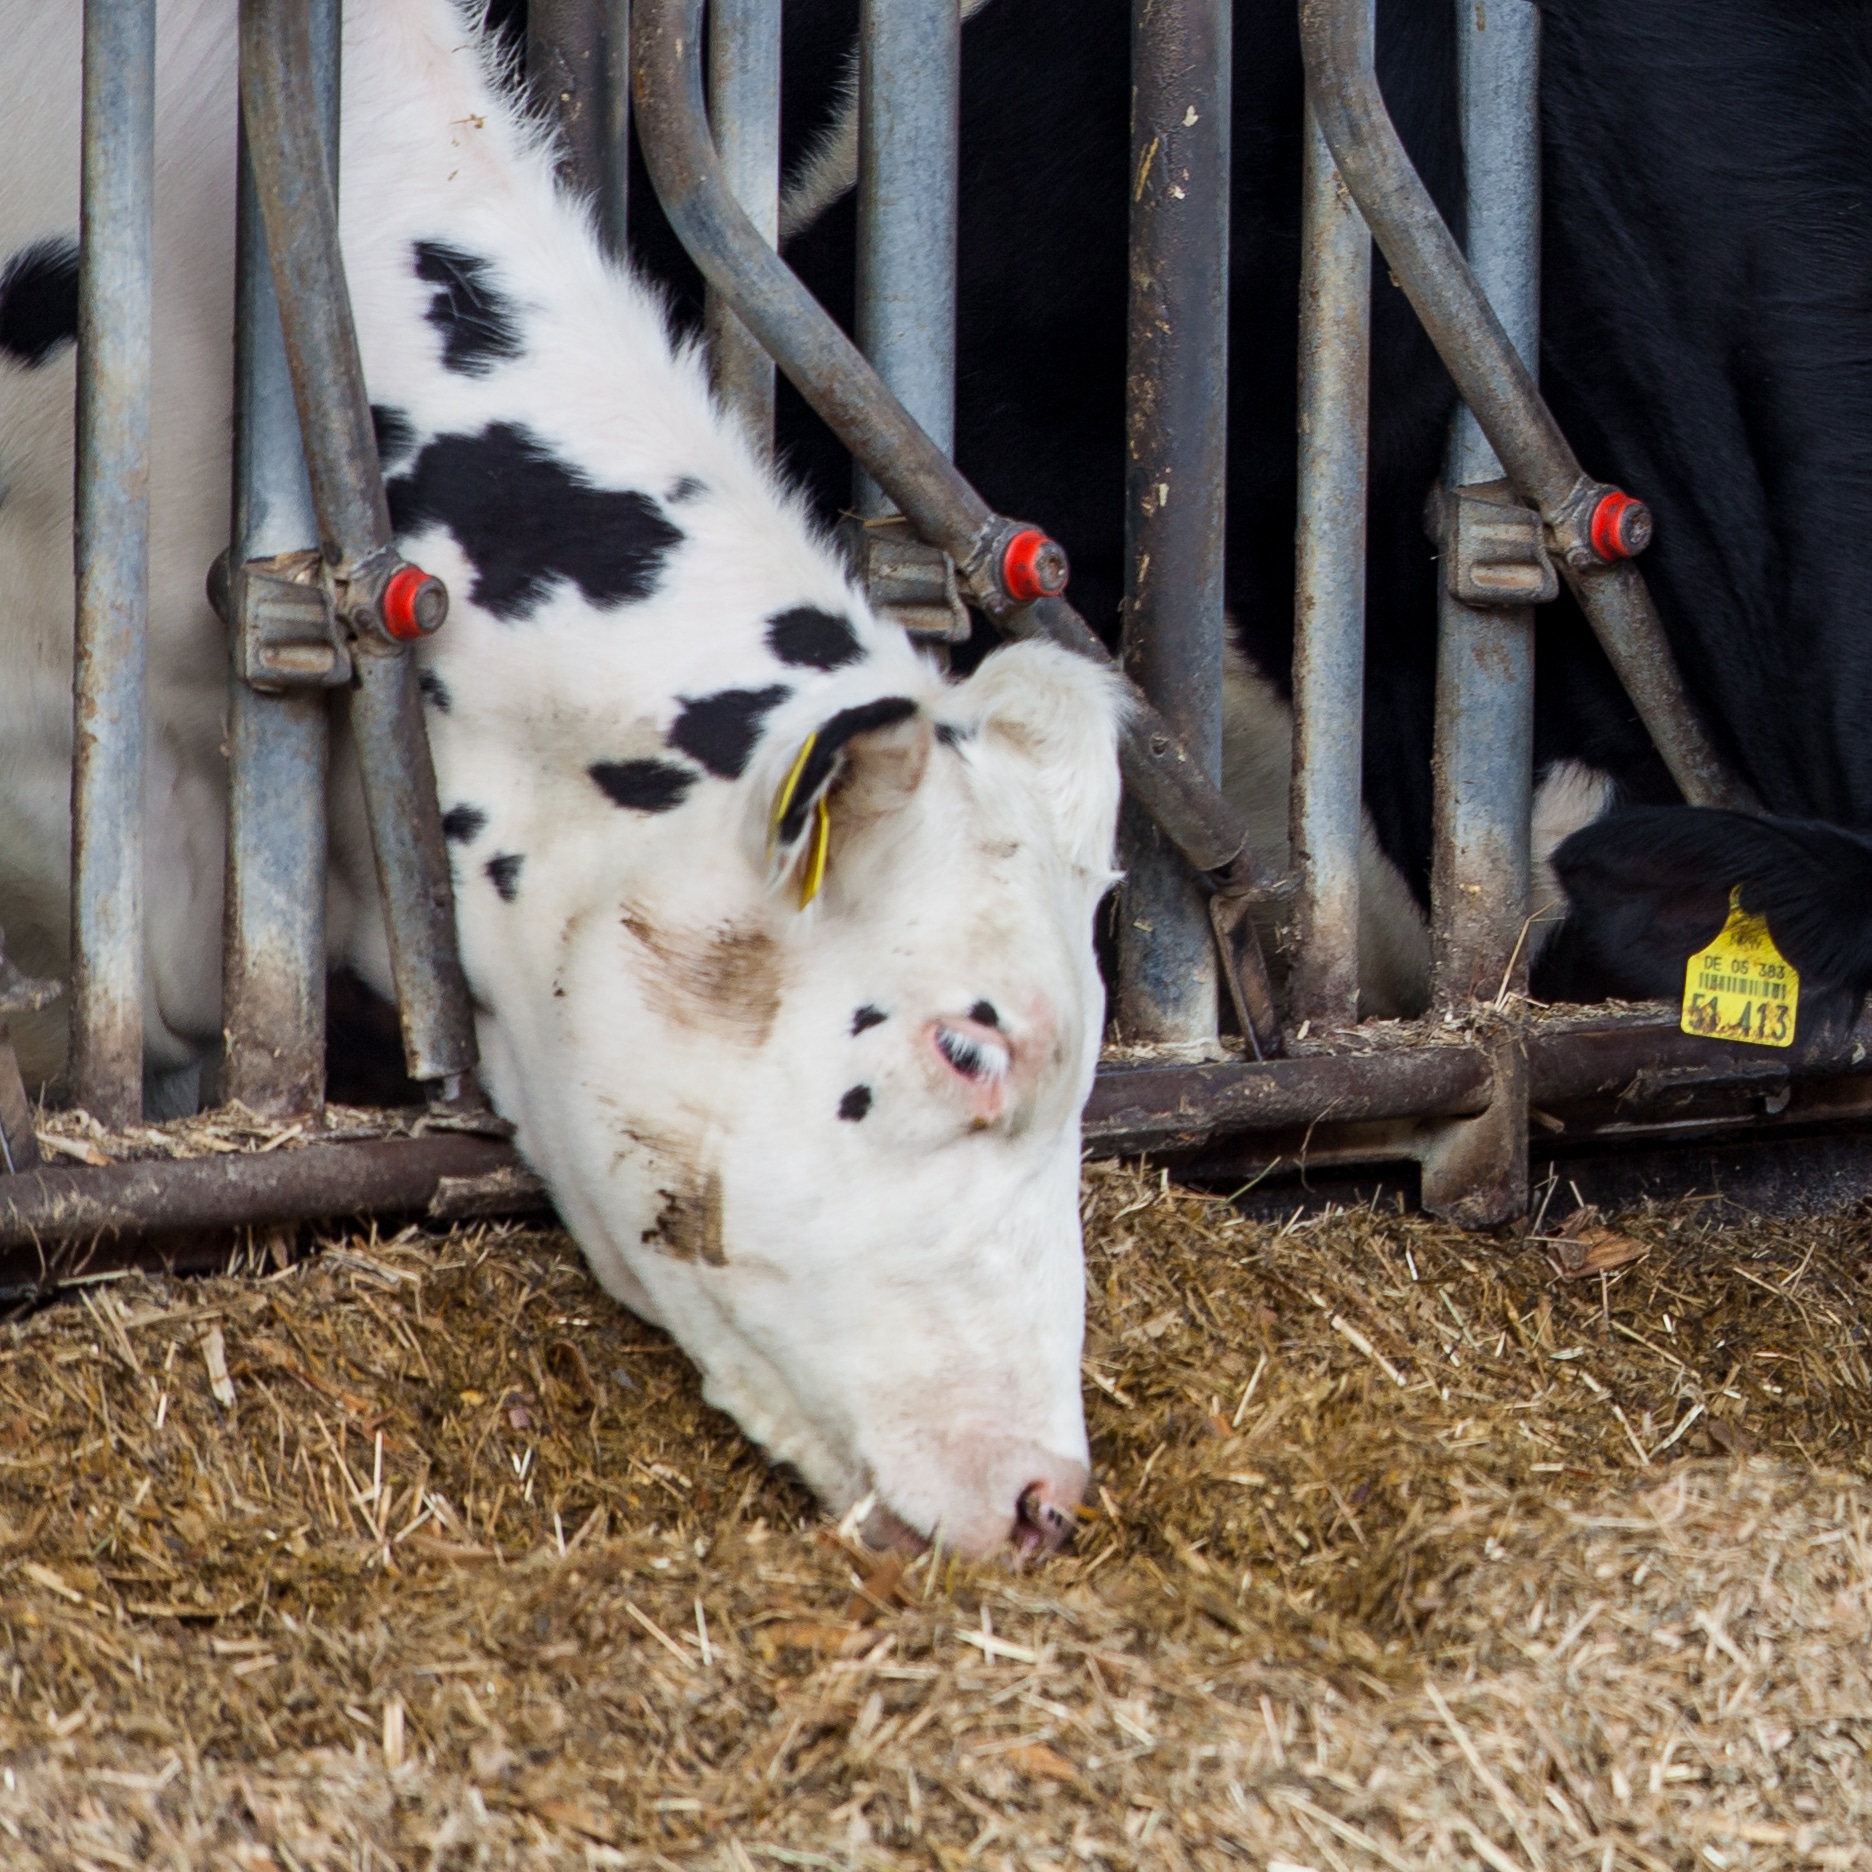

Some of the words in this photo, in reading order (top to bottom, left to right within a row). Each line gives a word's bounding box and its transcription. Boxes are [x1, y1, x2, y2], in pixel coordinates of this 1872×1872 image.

[1704, 955, 1723, 971] DE
[1731, 958, 1749, 975] 05
[1758, 962, 1786, 980] 383
[1737, 1000, 1789, 1042] 413
